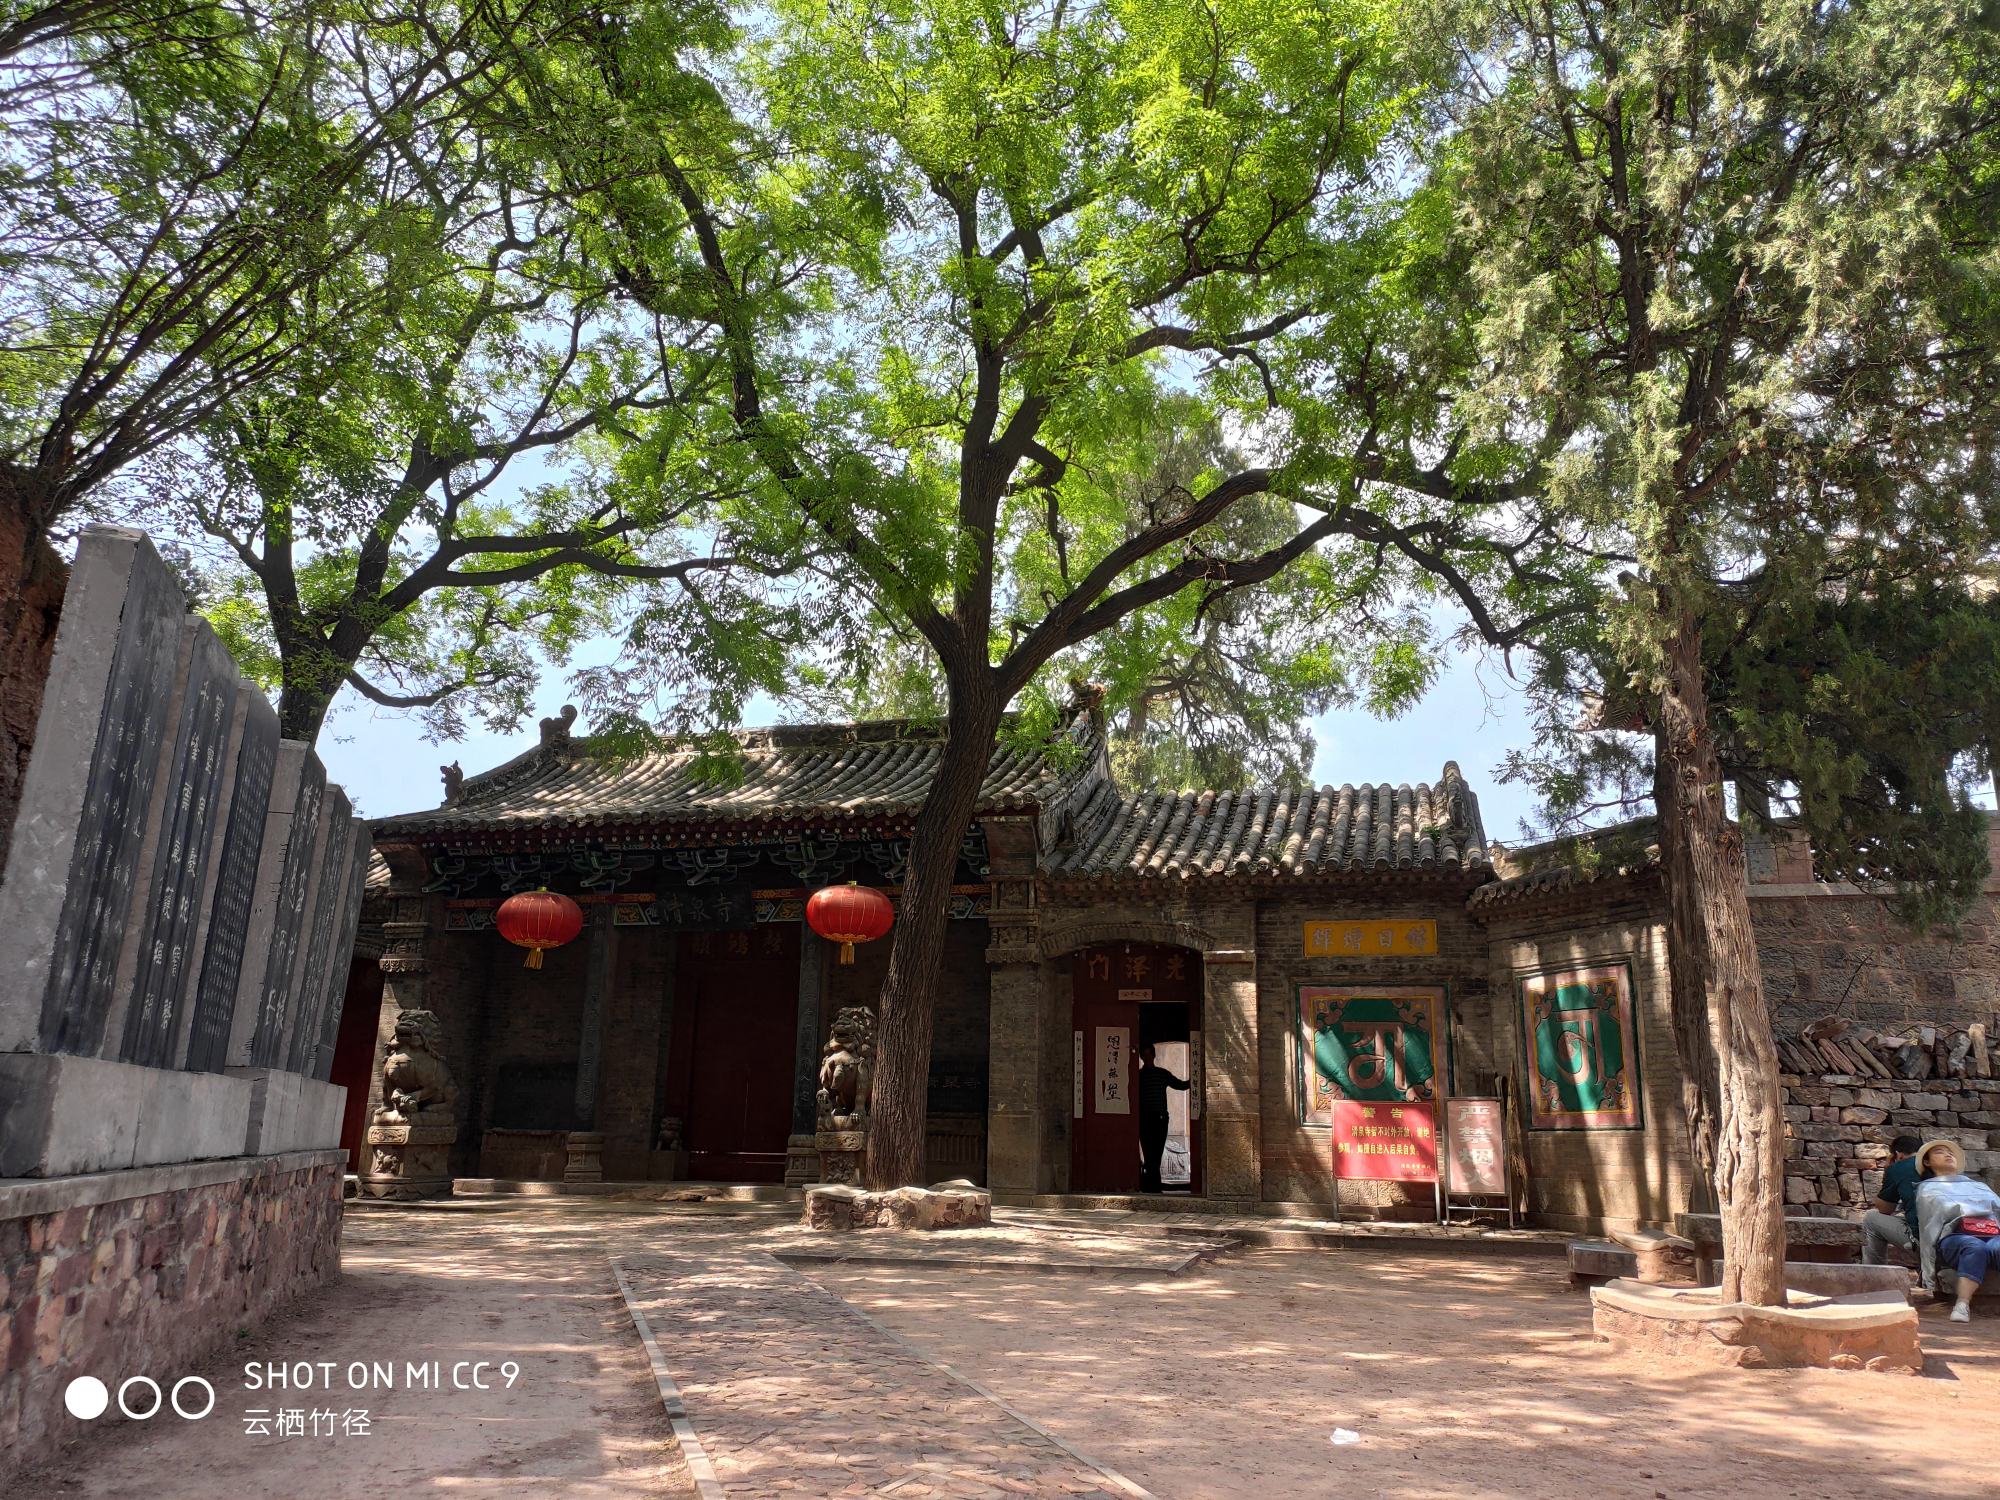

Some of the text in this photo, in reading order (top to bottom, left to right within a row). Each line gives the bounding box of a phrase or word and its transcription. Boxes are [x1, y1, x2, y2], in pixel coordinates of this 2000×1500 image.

[661, 892, 734, 925] 清泉寺
[1362, 1107, 1404, 1119] 警告
[1457, 1105, 1496, 1187] 严禁烟火
